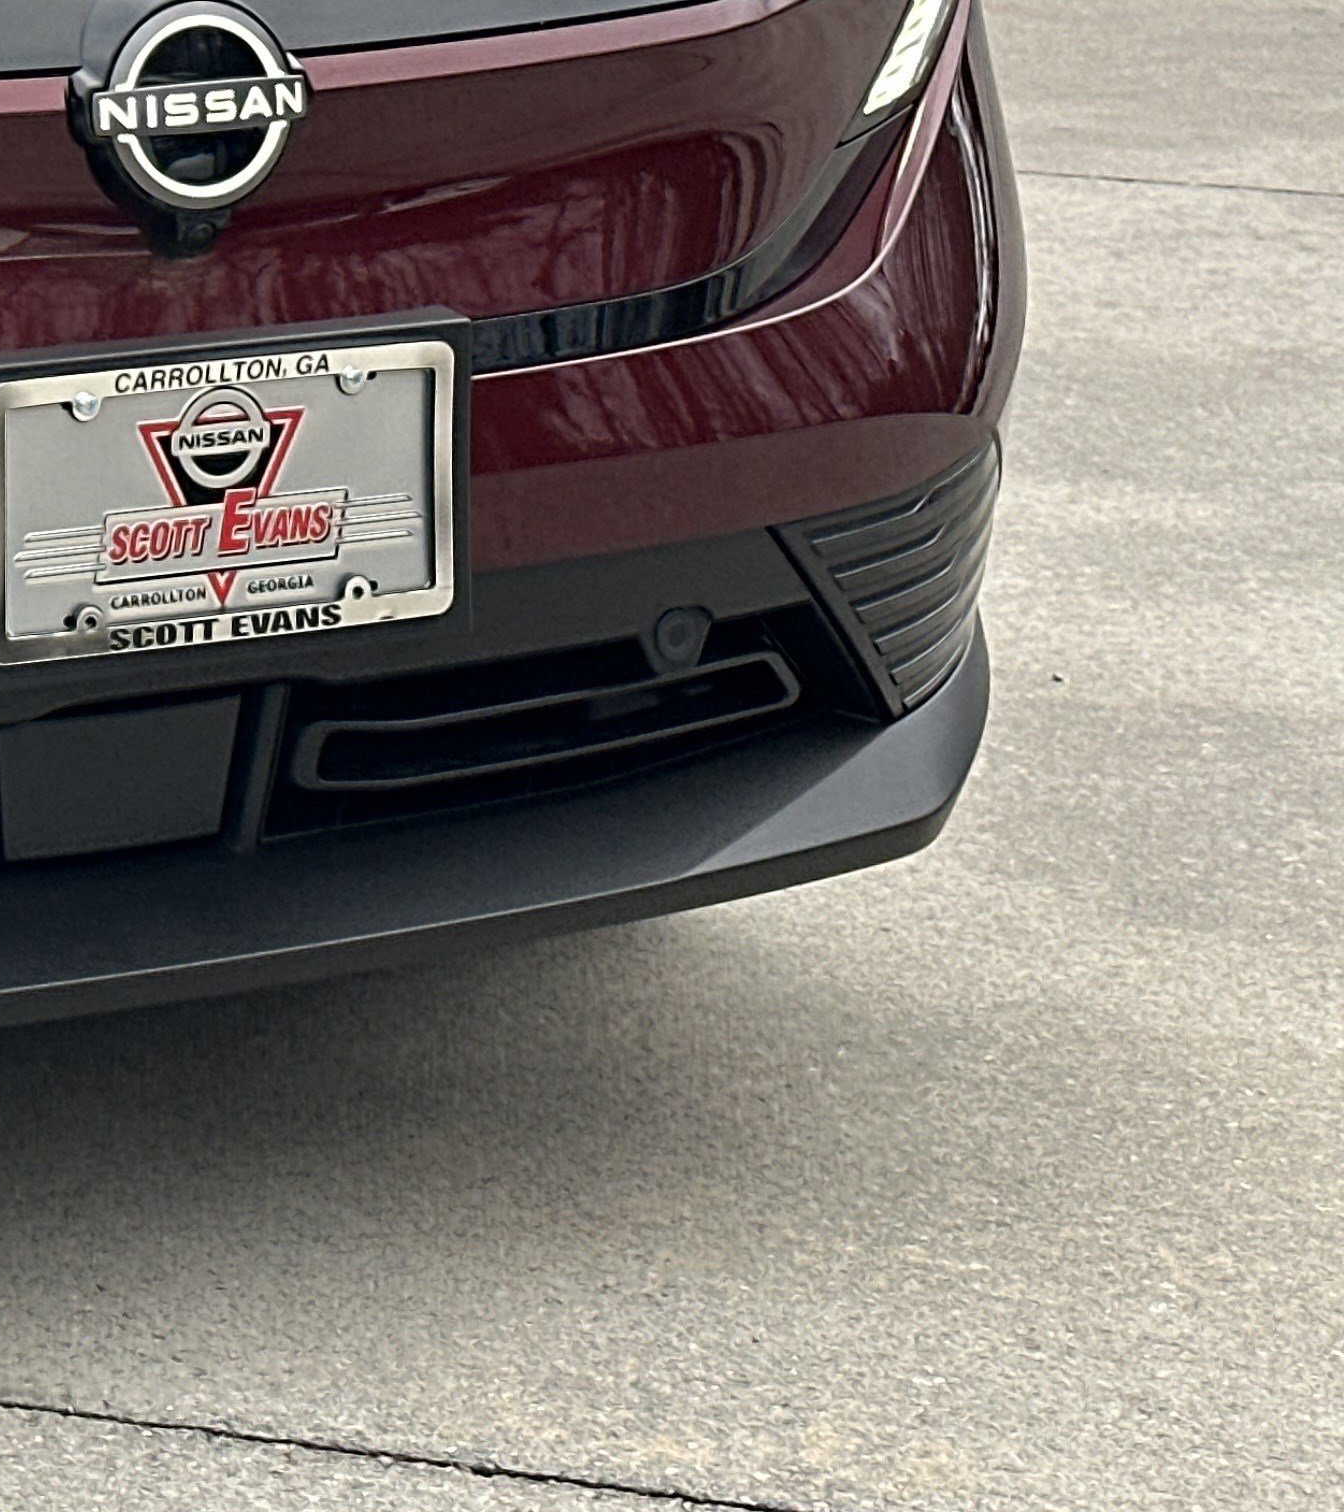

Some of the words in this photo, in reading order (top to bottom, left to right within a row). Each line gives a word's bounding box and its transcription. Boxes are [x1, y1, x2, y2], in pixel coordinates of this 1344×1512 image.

[98, 81, 304, 133] NISSAN
[114, 356, 288, 394] CARROLLTON,
[296, 353, 330, 376] GA
[177, 427, 264, 451] NISSAN
[107, 515, 212, 565] SCOTT
[110, 587, 207, 611] CARROLLTON
[246, 574, 315, 596] GEORGIA
[108, 617, 220, 652] SCOTT
[230, 603, 343, 638] EVANS
